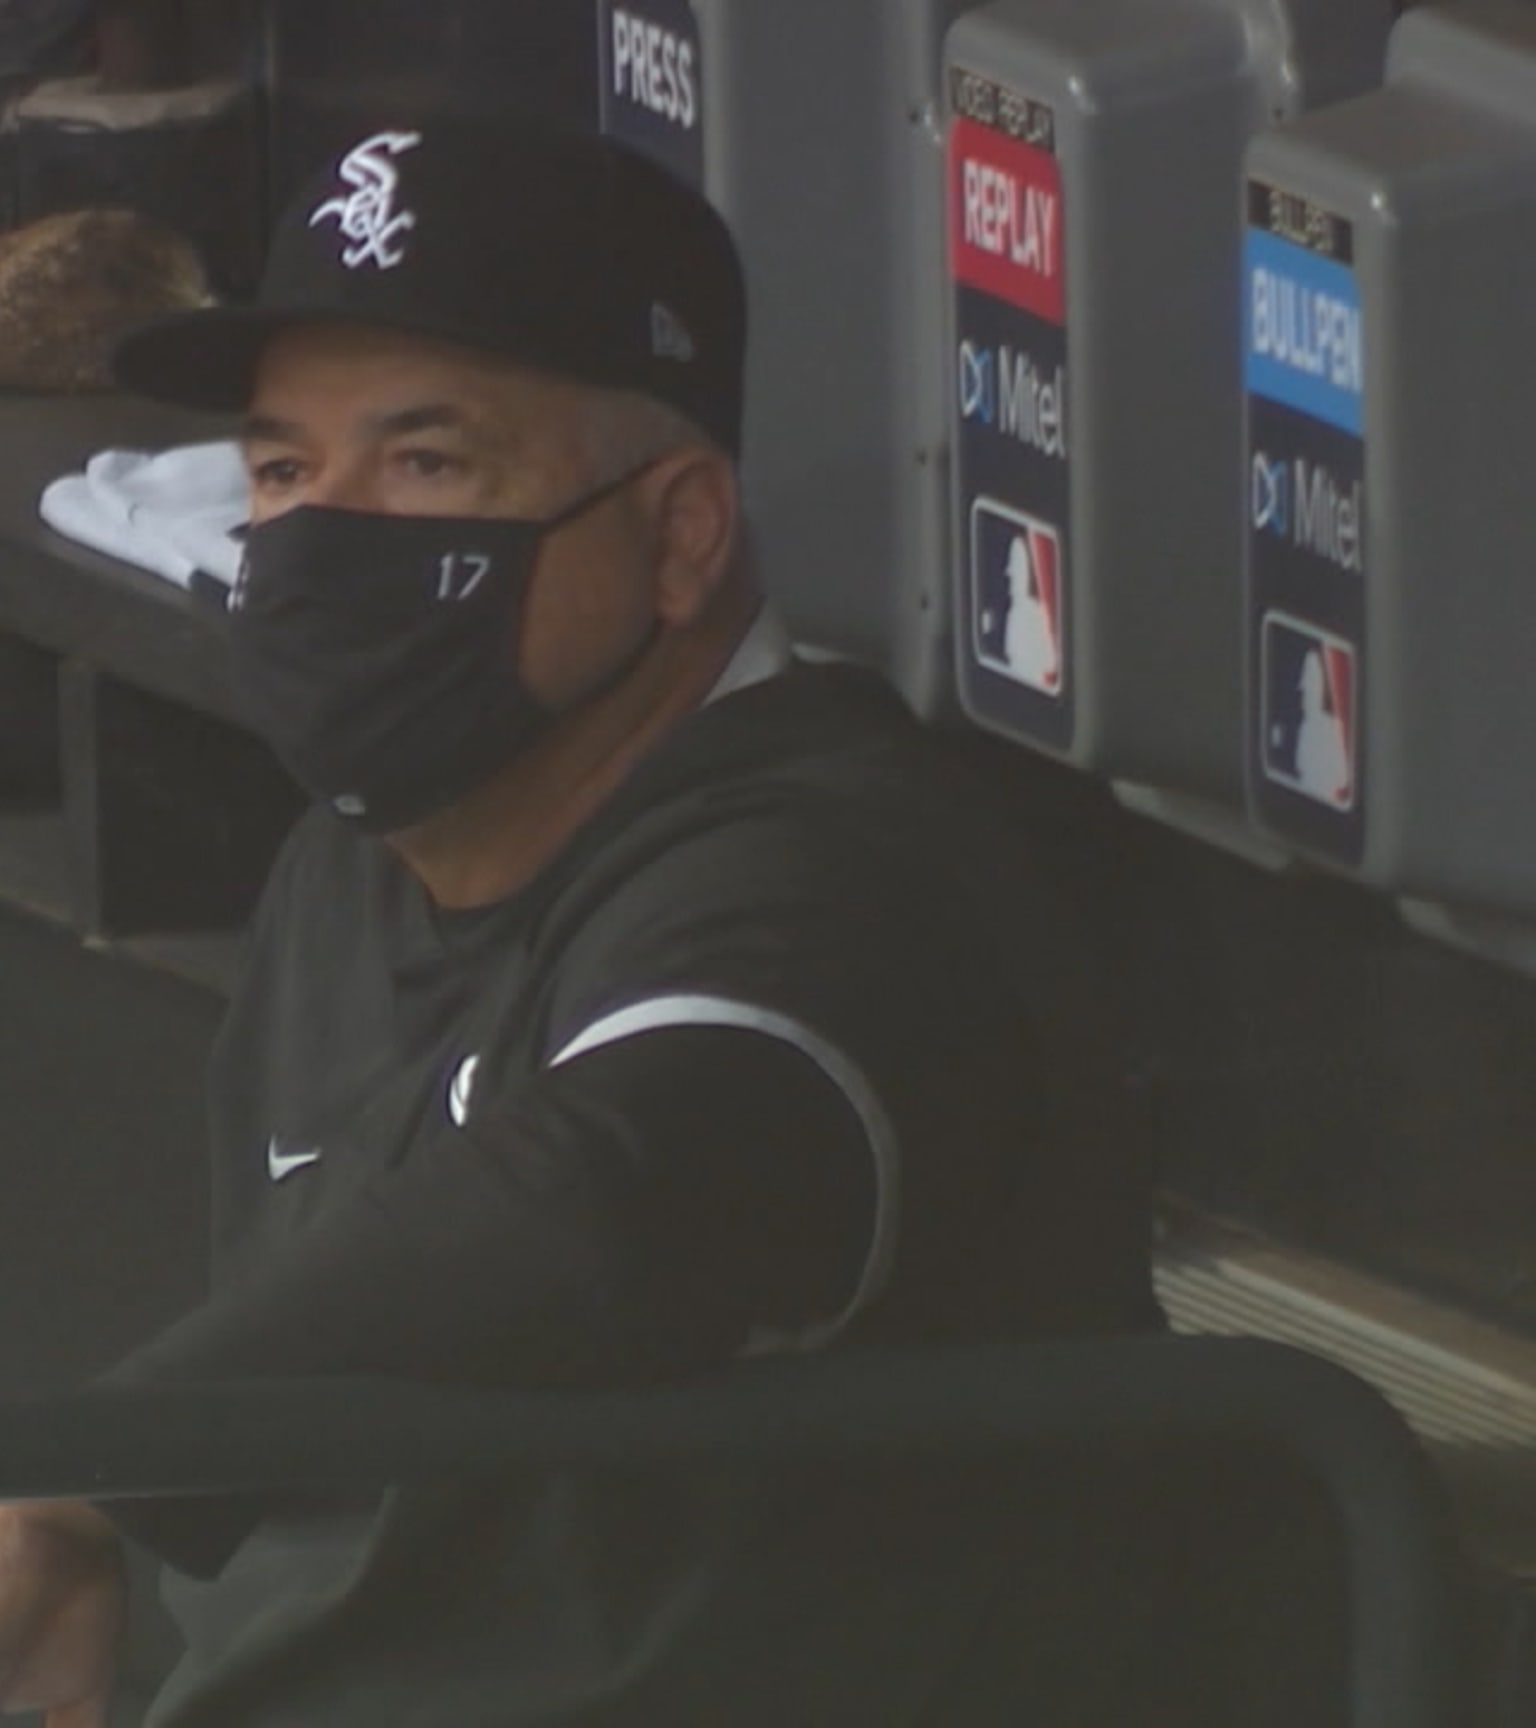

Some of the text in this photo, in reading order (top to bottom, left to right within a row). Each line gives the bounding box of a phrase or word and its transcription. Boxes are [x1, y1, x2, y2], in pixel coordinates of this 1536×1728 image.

[612, 9, 693, 128] PRESS
[963, 158, 1054, 277] REPLAY
[1252, 267, 1361, 393] BULLPEN
[998, 344, 1065, 459] Mitel
[1294, 458, 1363, 573] Mitel
[437, 552, 490, 599] 17
